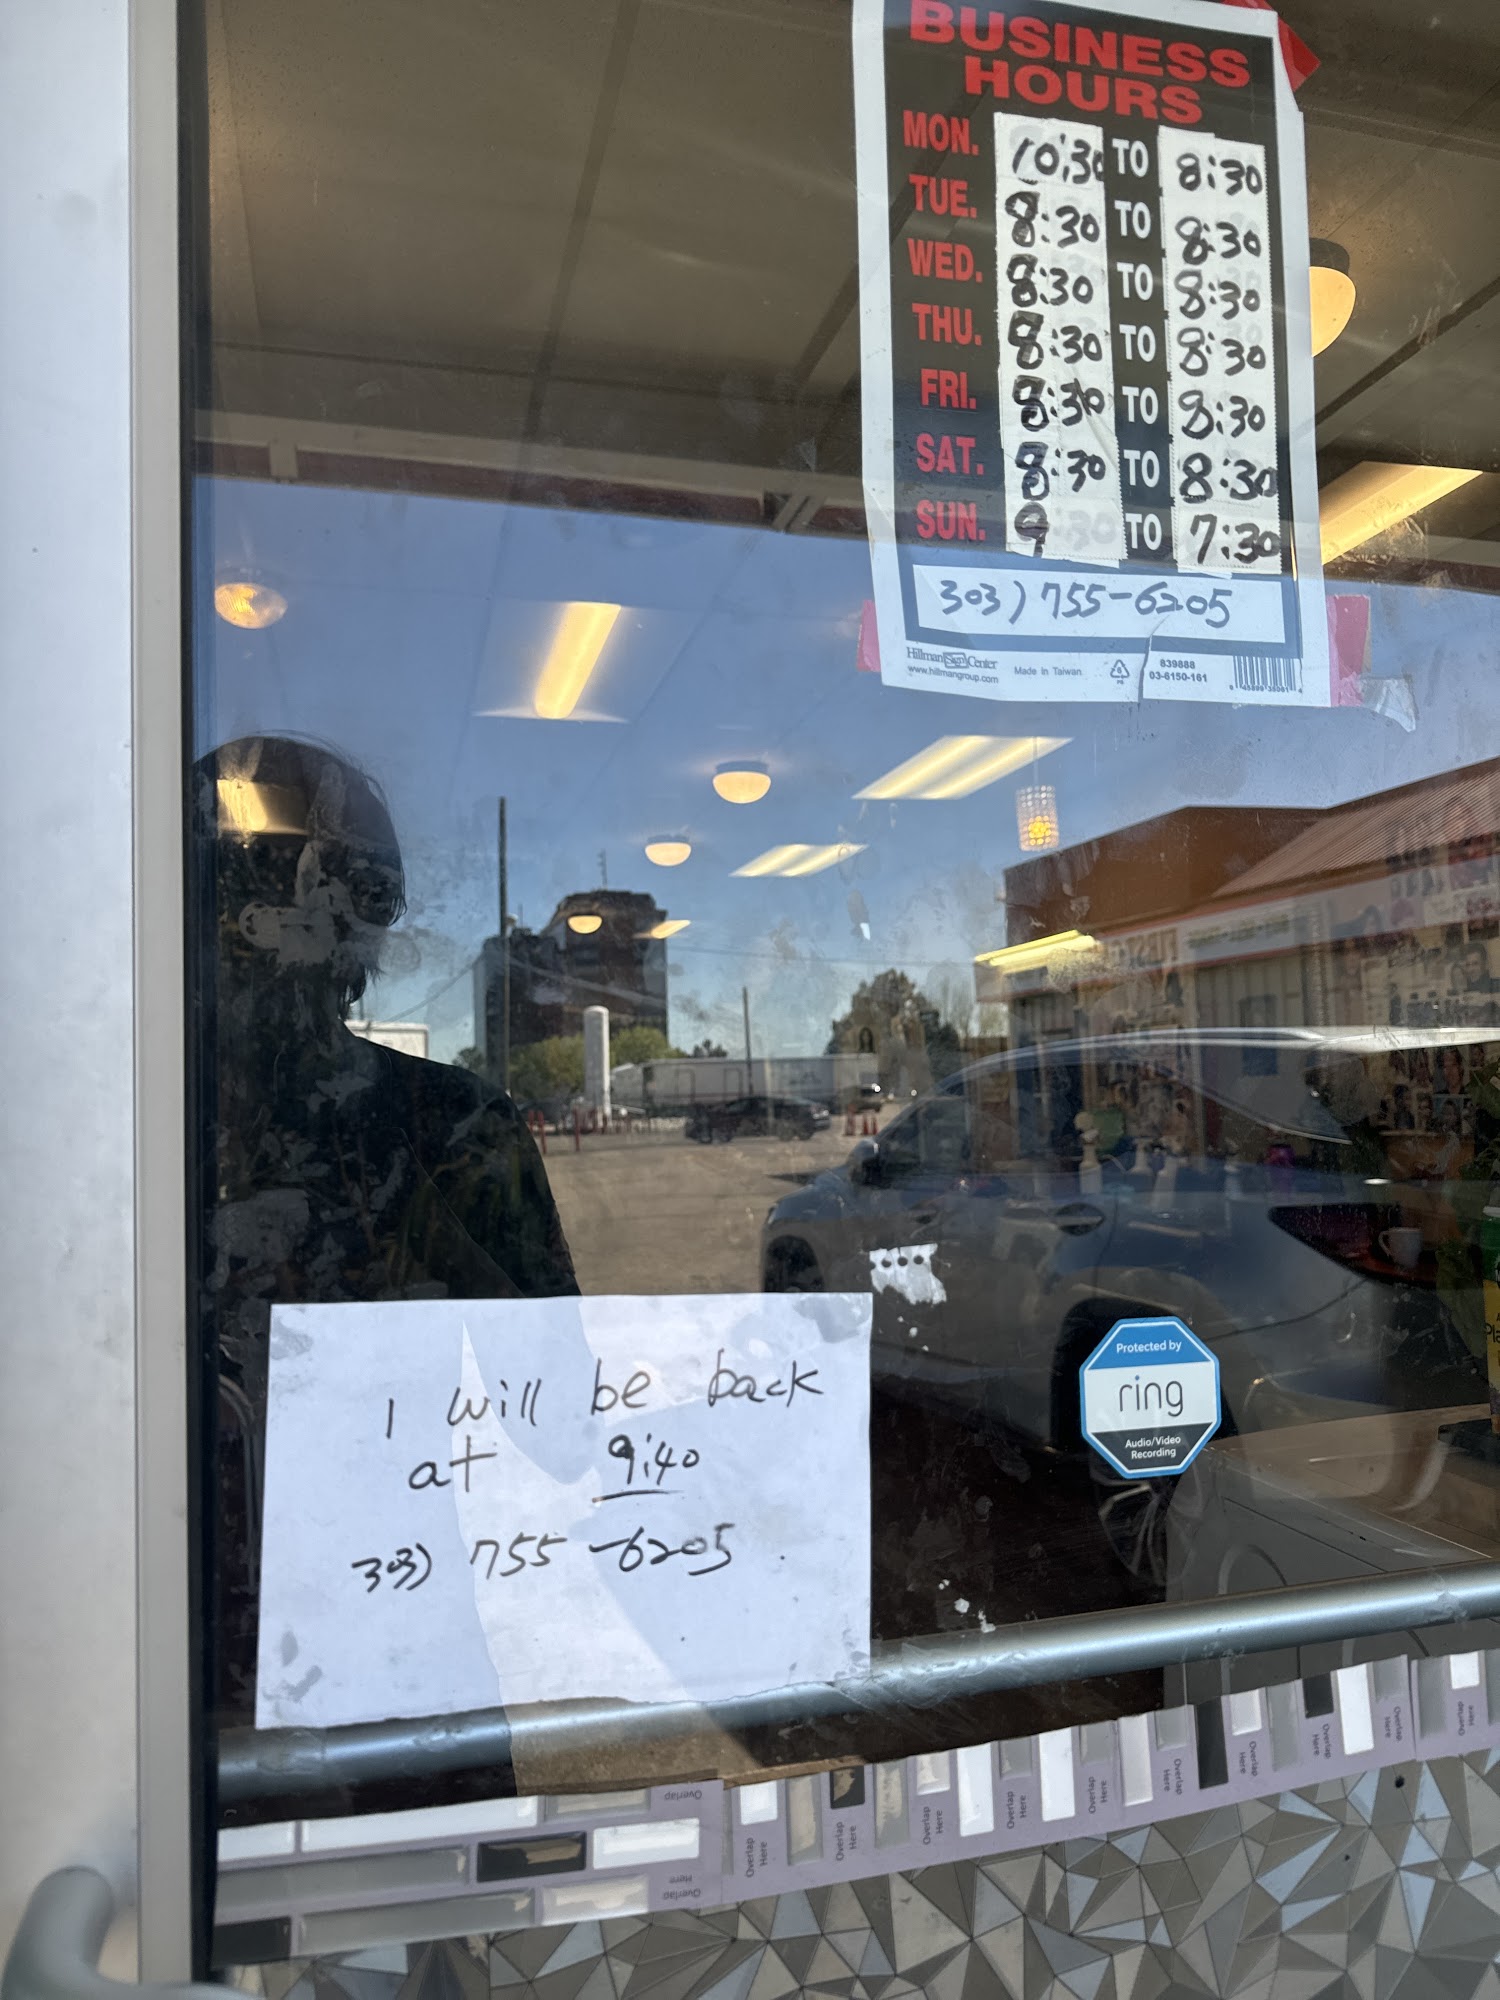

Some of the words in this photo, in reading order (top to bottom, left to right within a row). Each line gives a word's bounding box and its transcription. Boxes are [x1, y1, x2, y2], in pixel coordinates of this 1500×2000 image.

[910, 1, 1250, 88] BUSINESS
[964, 55, 1203, 124] HOURS
[903, 110, 980, 156] MON.
[1012, 133, 1104, 185] 10:30
[1112, 138, 1149, 177] TO
[1176, 153, 1264, 196] 8:30
[909, 174, 978, 219] TUE.
[1005, 191, 1100, 248] 8:30
[1114, 200, 1152, 239] TO
[1175, 216, 1262, 265] 8:30
[908, 239, 983, 283] WED.
[1007, 253, 1094, 308] 8:30
[1117, 262, 1154, 301] TO
[1174, 269, 1261, 320] 8:30
[913, 303, 982, 346] THU.
[1008, 310, 1103, 370] 8:30
[1119, 324, 1156, 363] TO
[1177, 327, 1266, 377] 8:30
[921, 369, 977, 409] FRI.
[1012, 375, 1105, 433] 8:30
[1122, 386, 1159, 425] TO
[1178, 389, 1266, 440] 8:30
[916, 433, 985, 475] SAT.
[1015, 441, 1106, 501] 8:30
[1123, 450, 1160, 488] TO
[1179, 453, 1278, 504] 8:30
[916, 500, 986, 541] SUN.
[1125, 513, 1162, 551] TO
[1190, 513, 1282, 564] 7:30
[907, 664, 999, 684] www.hillmangroup.com
[1014, 666, 1037, 676] Made
[1041, 666, 1048, 676] in
[1052, 667, 1082, 676] Taiwan
[1149, 671, 1207, 683] 03-6150-161
[1159, 659, 1196, 669] 839888
[1116, 1341, 1167, 1354] Protected
[1168, 1340, 1182, 1352] by
[447, 1379, 542, 1427] will
[590, 1358, 651, 1416] be
[708, 1349, 824, 1407] back
[1119, 1375, 1183, 1417] ring
[1125, 1436, 1181, 1449] Audio/Video
[1131, 1448, 1176, 1460] Recording
[408, 1436, 498, 1493] at
[1088, 1776, 1096, 1814] Overlap
[1174, 1758, 1183, 1795] Overlap
[923, 1806, 931, 1845] Overlap
[1007, 1791, 1015, 1829] Overlap
[746, 1838, 754, 1877] Overlap
[836, 1822, 844, 1861] Overlap
